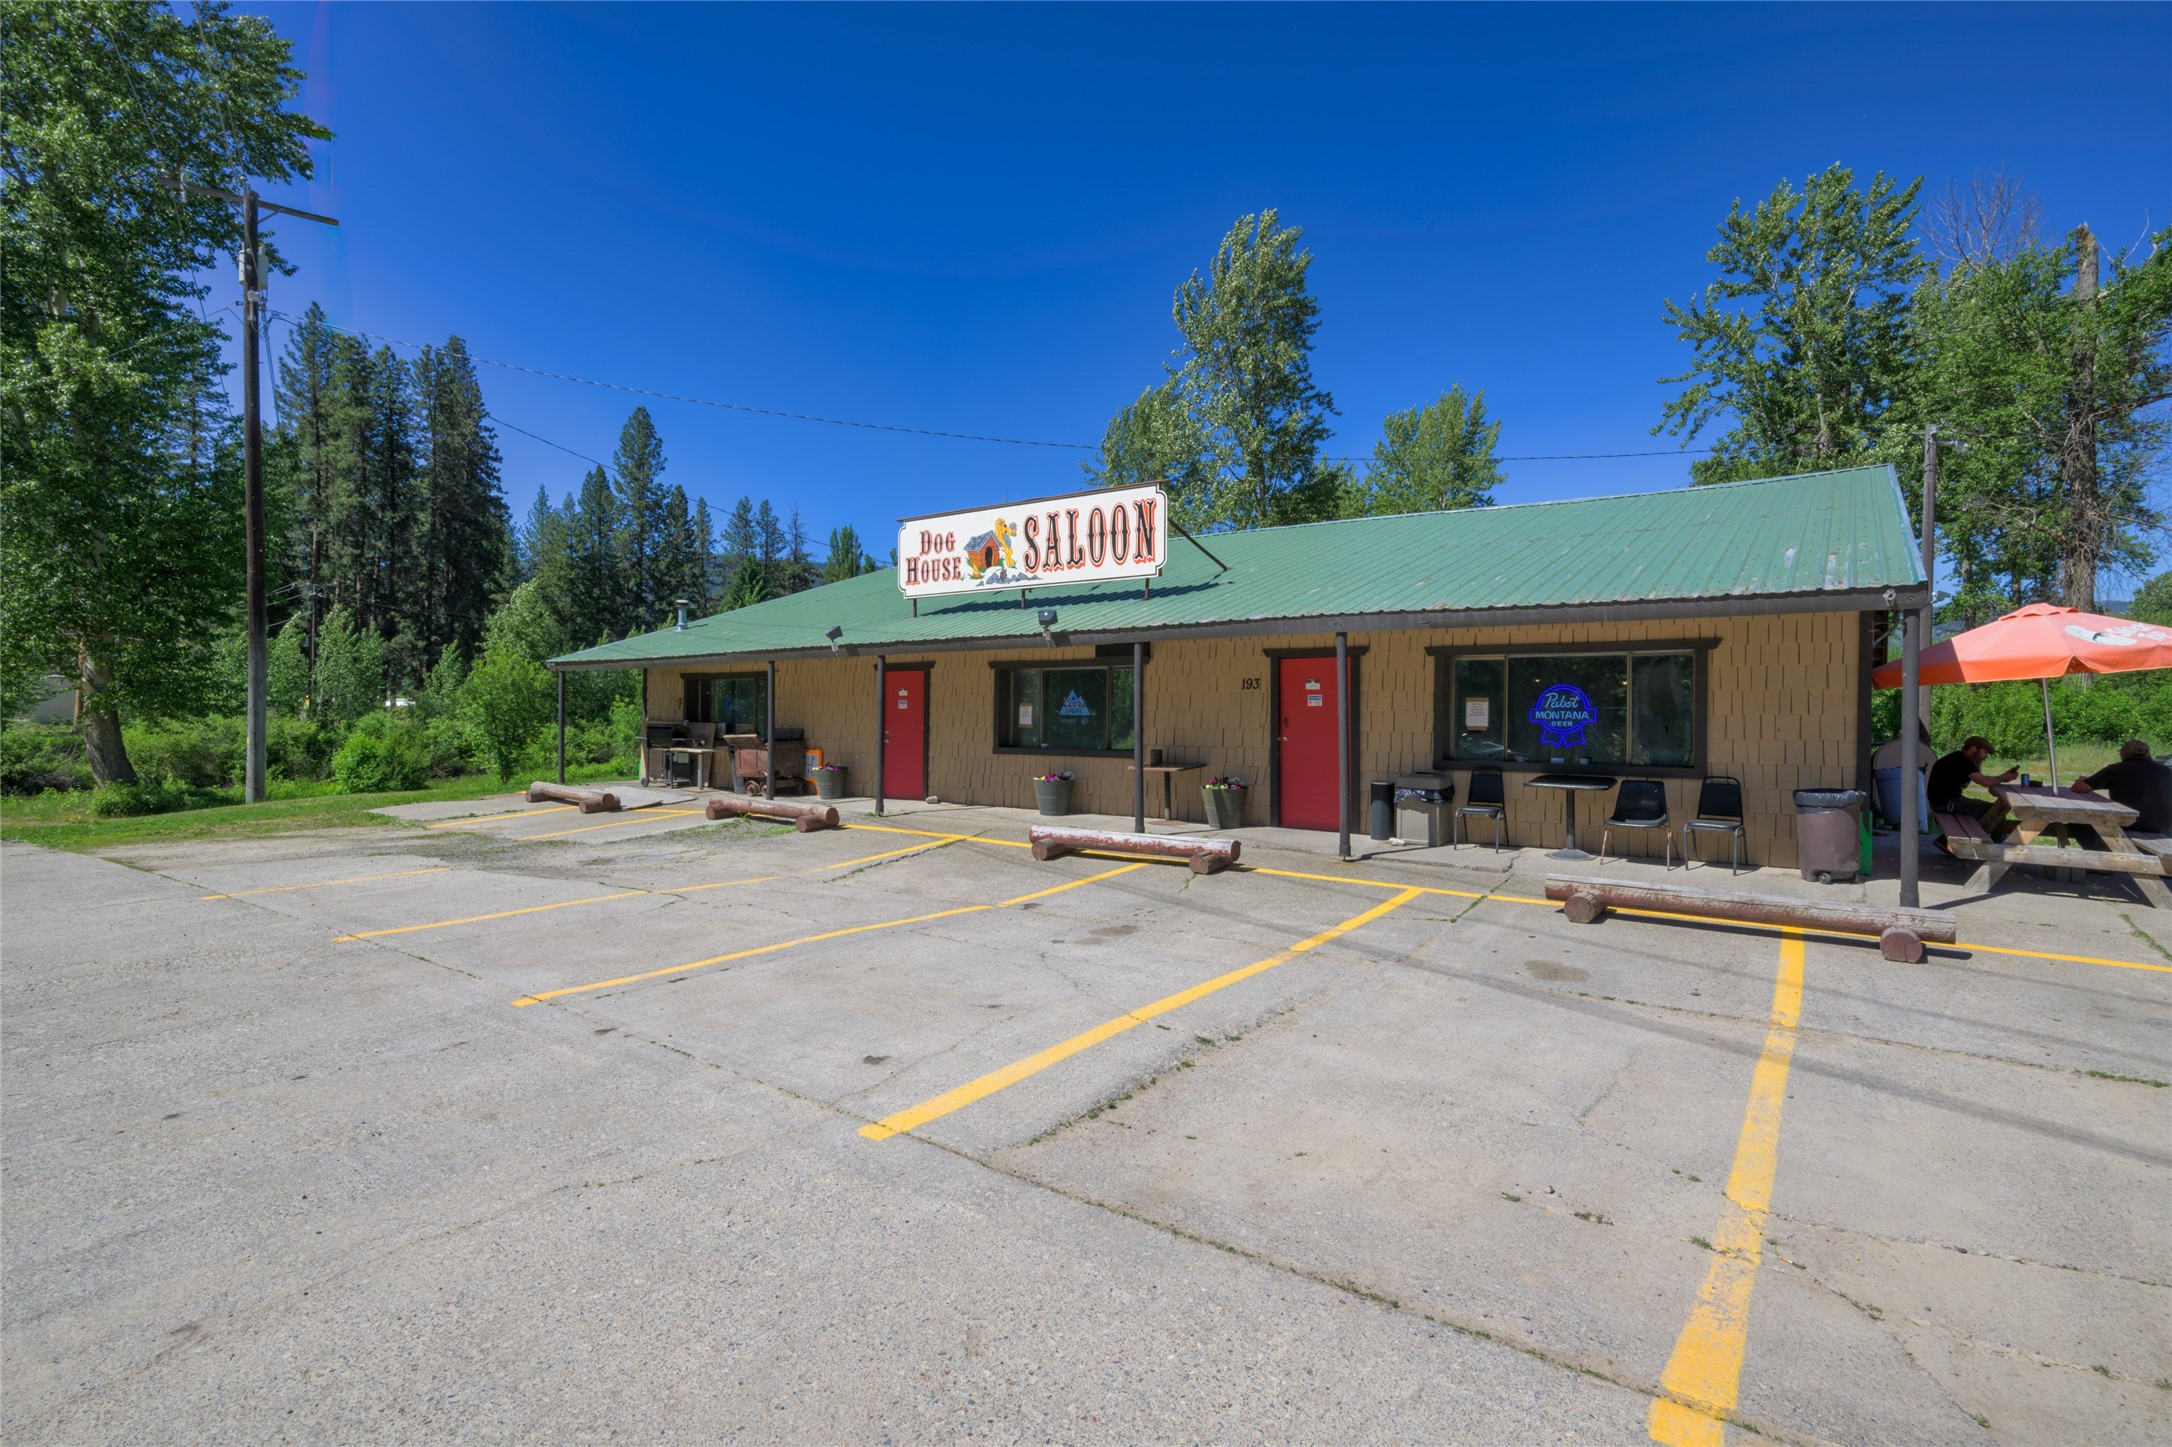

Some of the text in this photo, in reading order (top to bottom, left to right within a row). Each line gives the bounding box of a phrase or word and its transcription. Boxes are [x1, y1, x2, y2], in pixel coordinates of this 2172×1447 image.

[919, 530, 956, 556] DOG
[1023, 498, 1157, 573] SALOON
[905, 556, 962, 586] HOUSE
[1241, 678, 1261, 690] 193
[1545, 692, 1580, 709] Pabst
[1535, 710, 1590, 720] MONTANA
